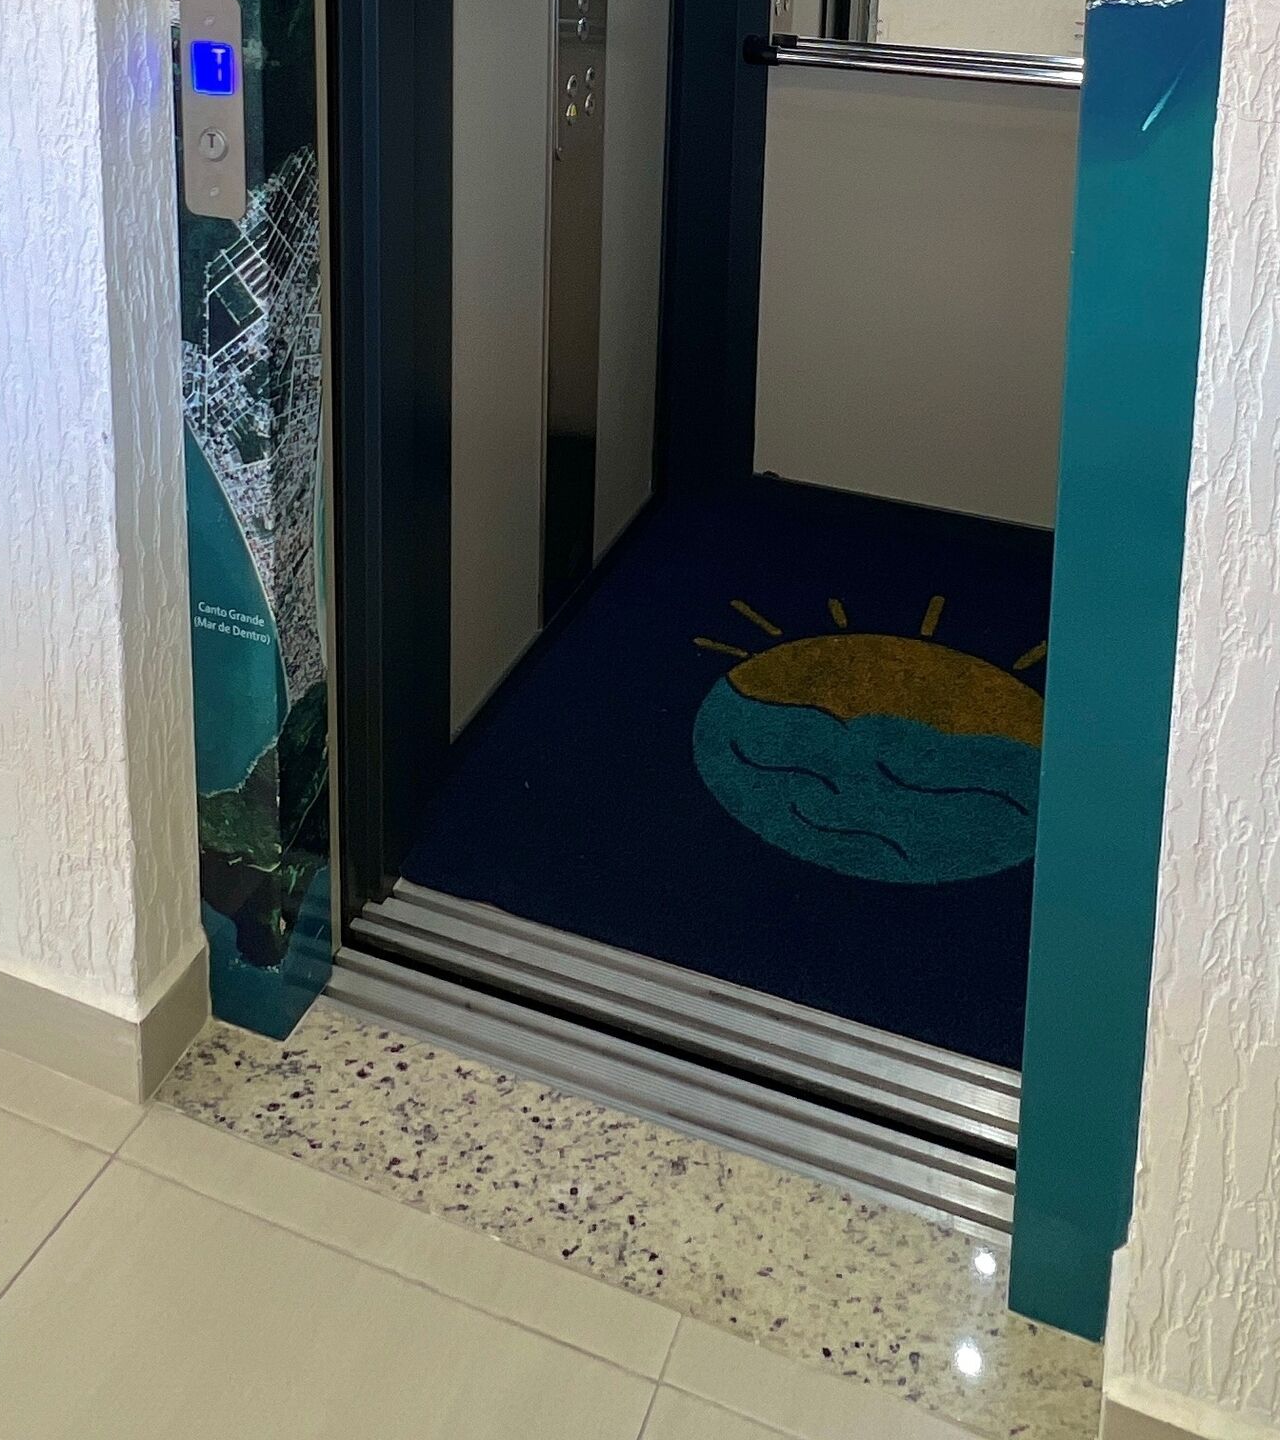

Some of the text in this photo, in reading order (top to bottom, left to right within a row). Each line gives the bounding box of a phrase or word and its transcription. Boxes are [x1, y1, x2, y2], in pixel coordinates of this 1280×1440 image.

[206, 133, 217, 149] T
[198, 601, 265, 627] Canto Grande
[193, 615, 271, 645] (Mar de Dentro)
